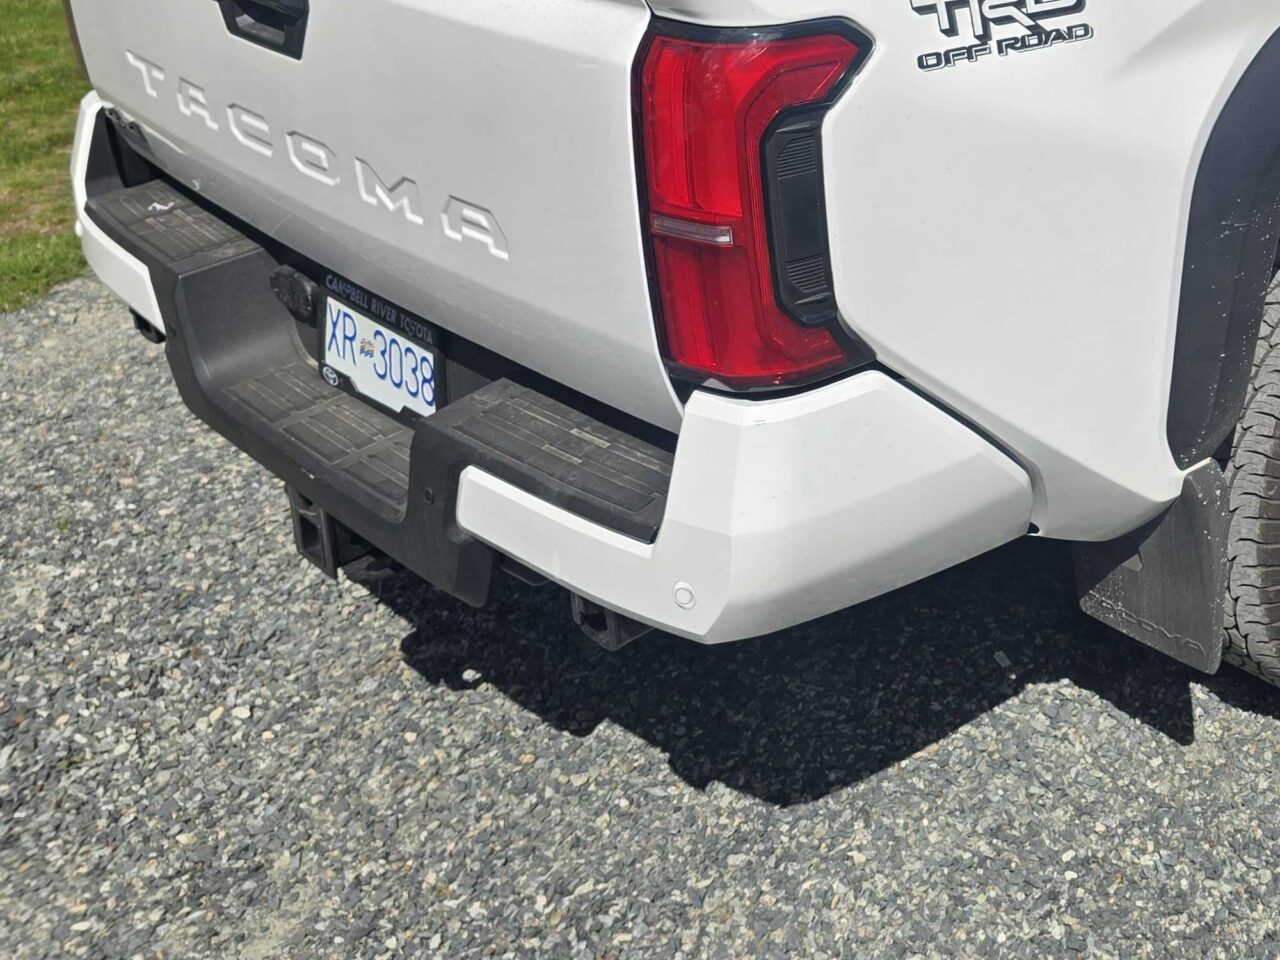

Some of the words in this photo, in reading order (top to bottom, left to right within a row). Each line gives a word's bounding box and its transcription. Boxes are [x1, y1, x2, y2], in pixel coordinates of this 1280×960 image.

[917, 47, 992, 72] OFF
[996, 23, 1094, 56] ROAD
[126, 49, 510, 261] TACOMA
[325, 274, 369, 309] CAMPBELL
[370, 298, 397, 324] RIVER
[400, 314, 434, 346] TOYOTA
[327, 303, 357, 367] XR
[373, 329, 436, 407] 3038
